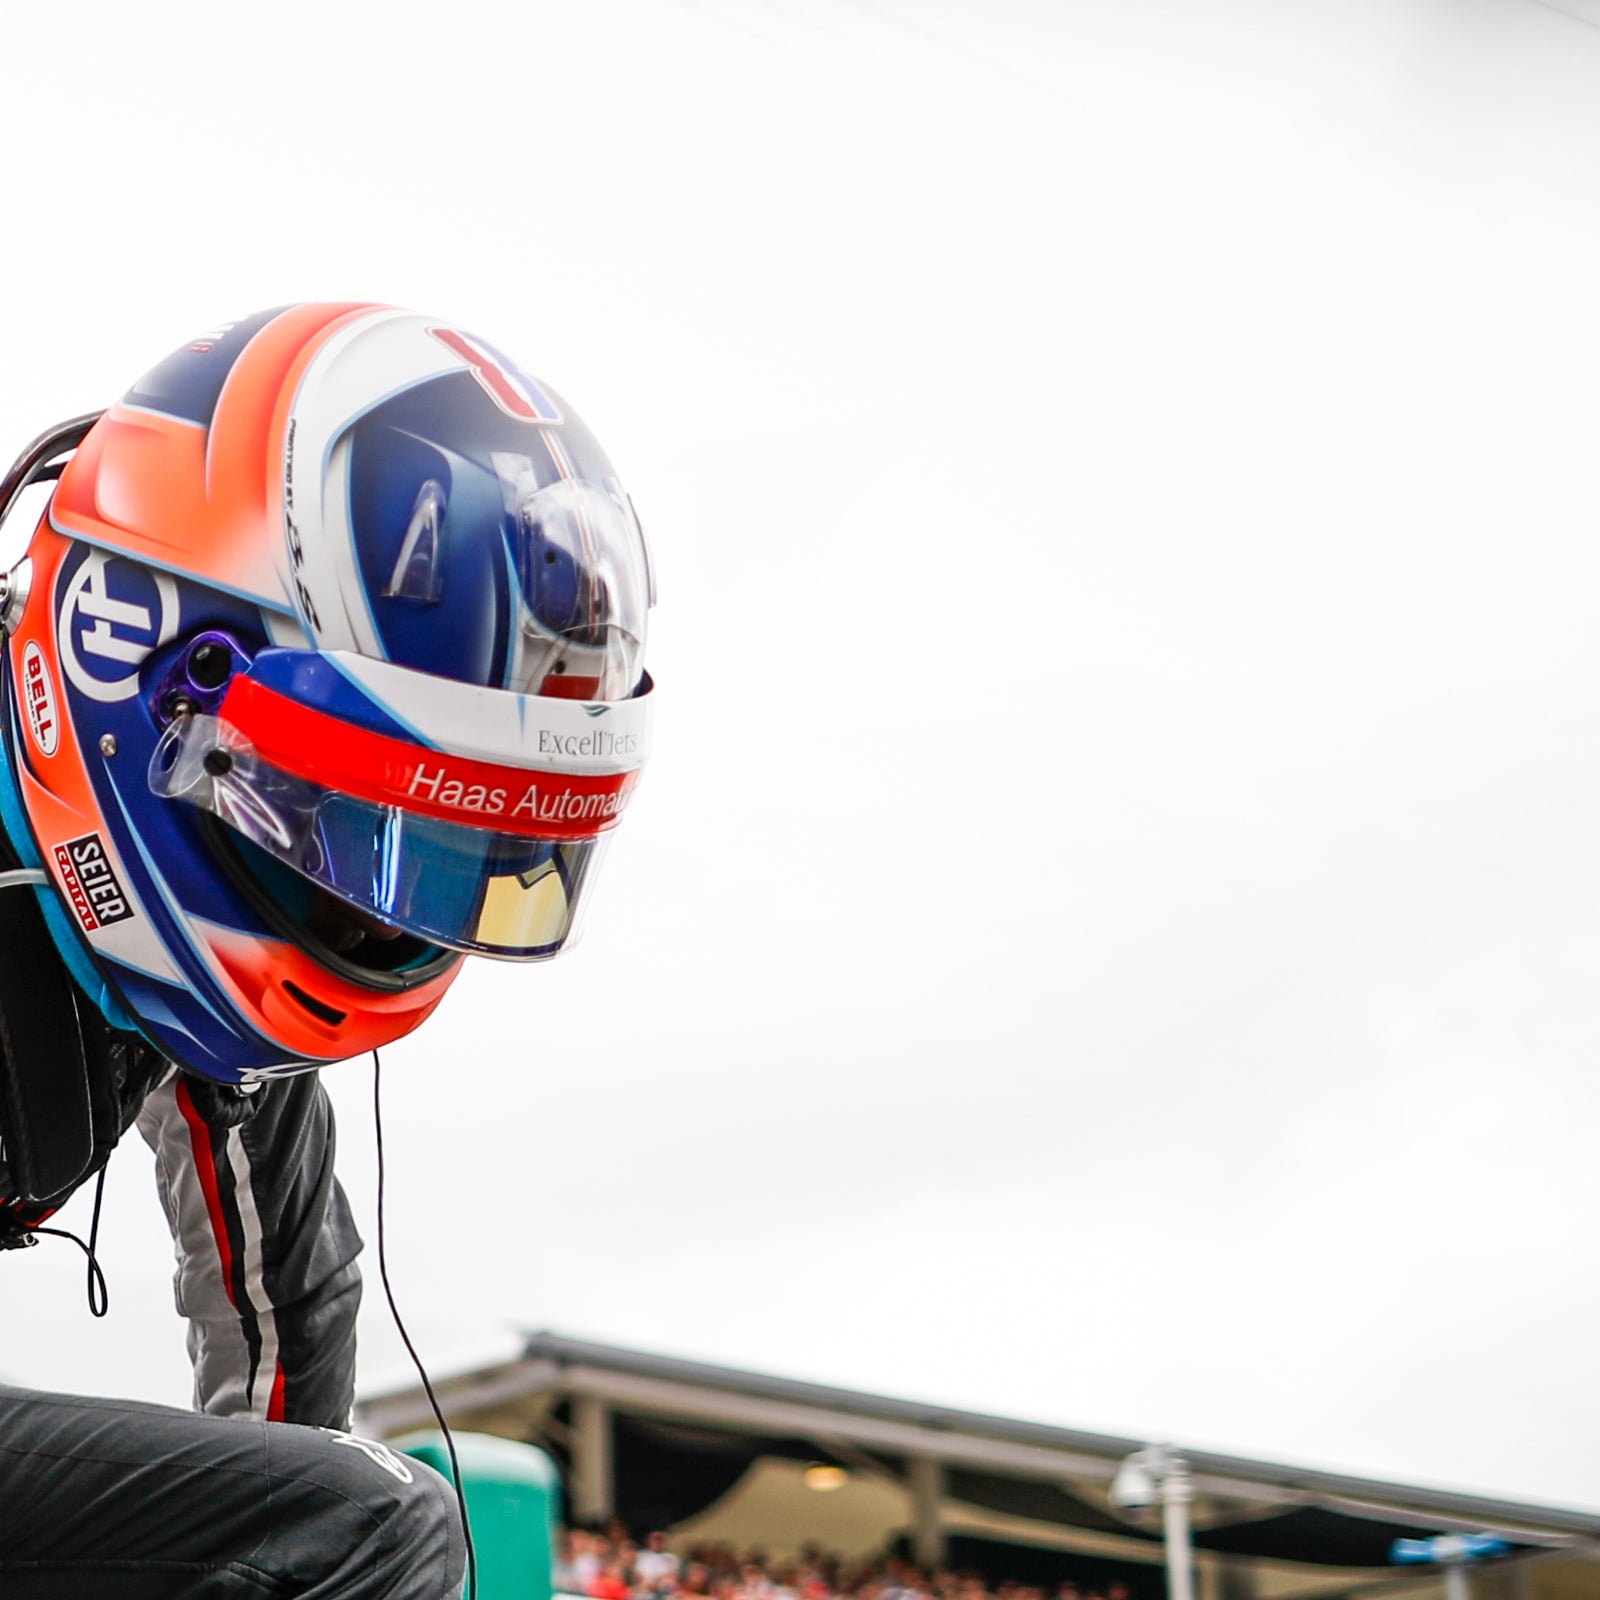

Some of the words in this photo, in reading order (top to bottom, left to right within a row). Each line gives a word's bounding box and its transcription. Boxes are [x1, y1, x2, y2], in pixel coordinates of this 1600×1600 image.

[28, 655, 52, 741] BELL
[408, 763, 507, 813] Haas
[58, 850, 93, 926] CAPITAL
[73, 841, 125, 920] SEIER
